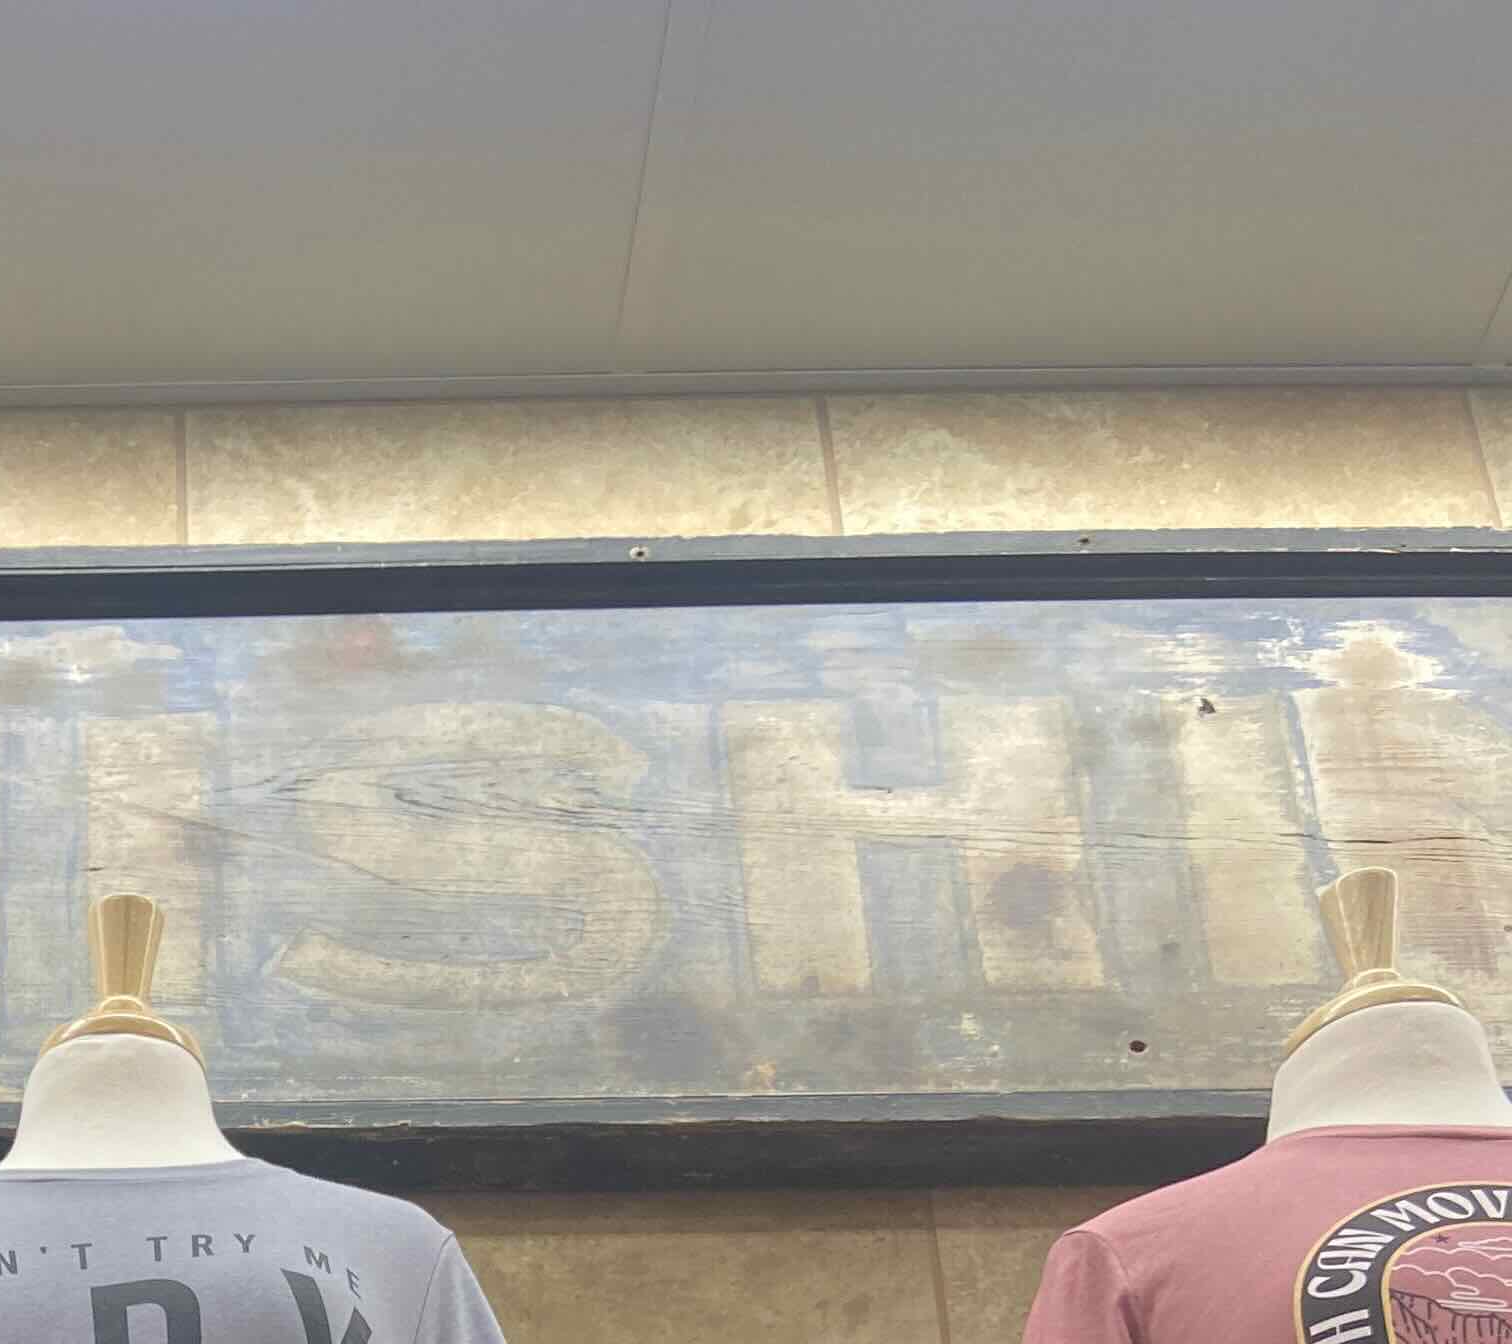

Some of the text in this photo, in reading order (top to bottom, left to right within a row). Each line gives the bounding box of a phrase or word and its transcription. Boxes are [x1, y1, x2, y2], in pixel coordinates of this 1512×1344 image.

[146, 1233, 256, 1262] TRY
[303, 1245, 361, 1298] ME
[1307, 1228, 1395, 1299] CAN
